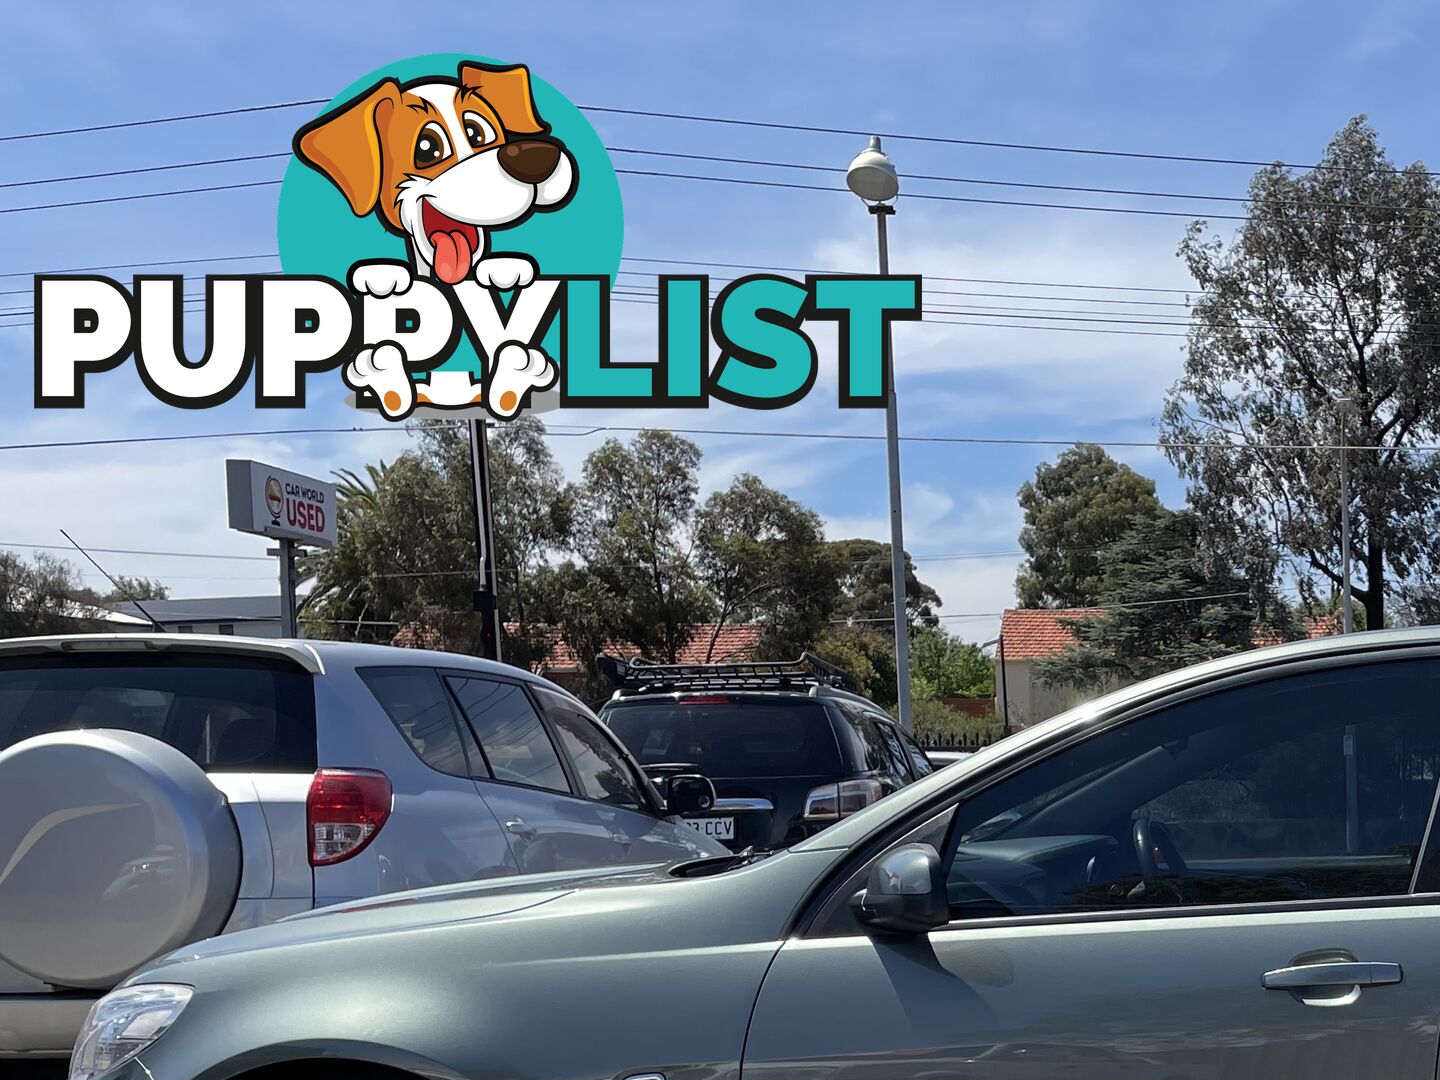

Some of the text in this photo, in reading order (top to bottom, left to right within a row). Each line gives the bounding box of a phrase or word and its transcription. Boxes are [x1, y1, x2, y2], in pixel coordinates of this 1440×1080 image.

[285, 483, 325, 504] CAR WORLD
[286, 499, 326, 533] USED
